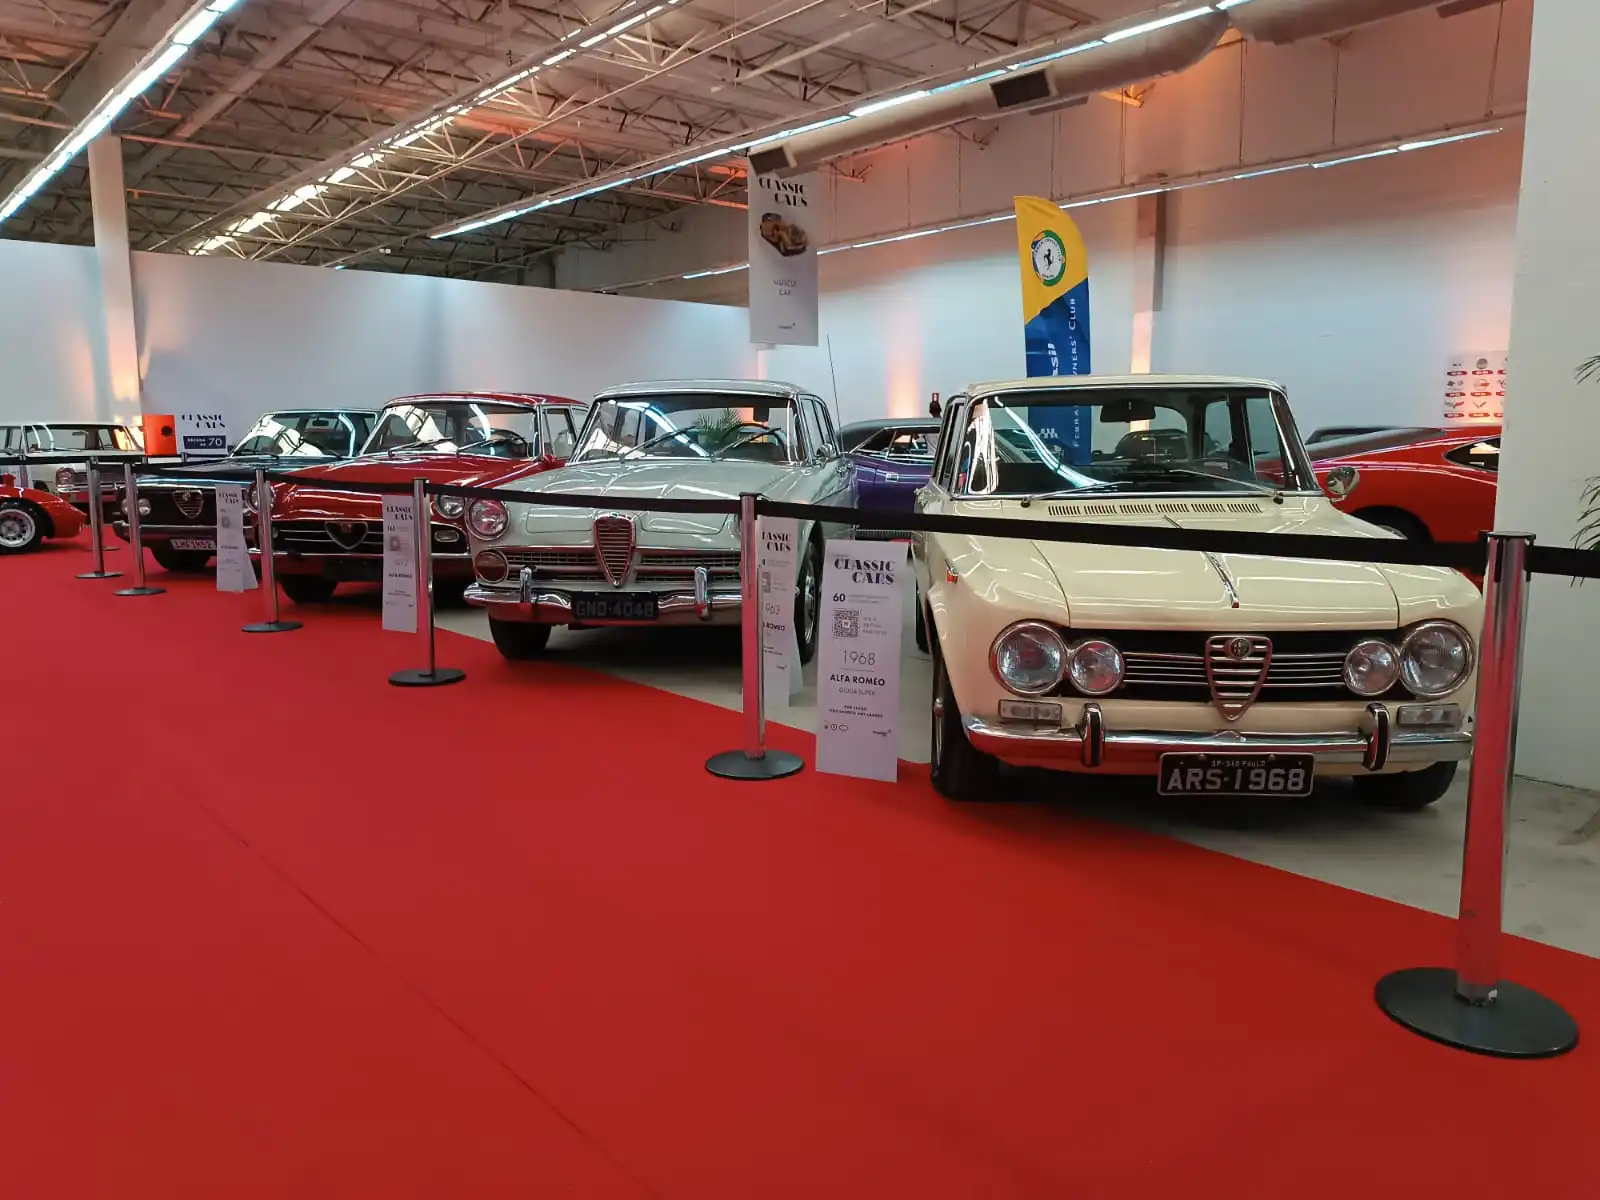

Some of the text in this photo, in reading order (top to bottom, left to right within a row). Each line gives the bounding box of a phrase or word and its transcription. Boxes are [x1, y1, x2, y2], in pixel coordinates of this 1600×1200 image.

[758, 177, 808, 194] CLASSIC
[774, 193, 808, 207] CARS
[208, 438, 222, 447] 70
[386, 505, 413, 514] CLASSIC
[761, 531, 791, 543] LASSIC
[766, 542, 791, 552] CARS
[834, 558, 896, 571] CLASSIC
[852, 571, 896, 585] CARS
[832, 592, 846, 602] 60
[764, 603, 781, 616] 963
[766, 624, 786, 632] ROMEO
[843, 650, 876, 666] 1968
[830, 674, 886, 686] ALFA ROMEO
